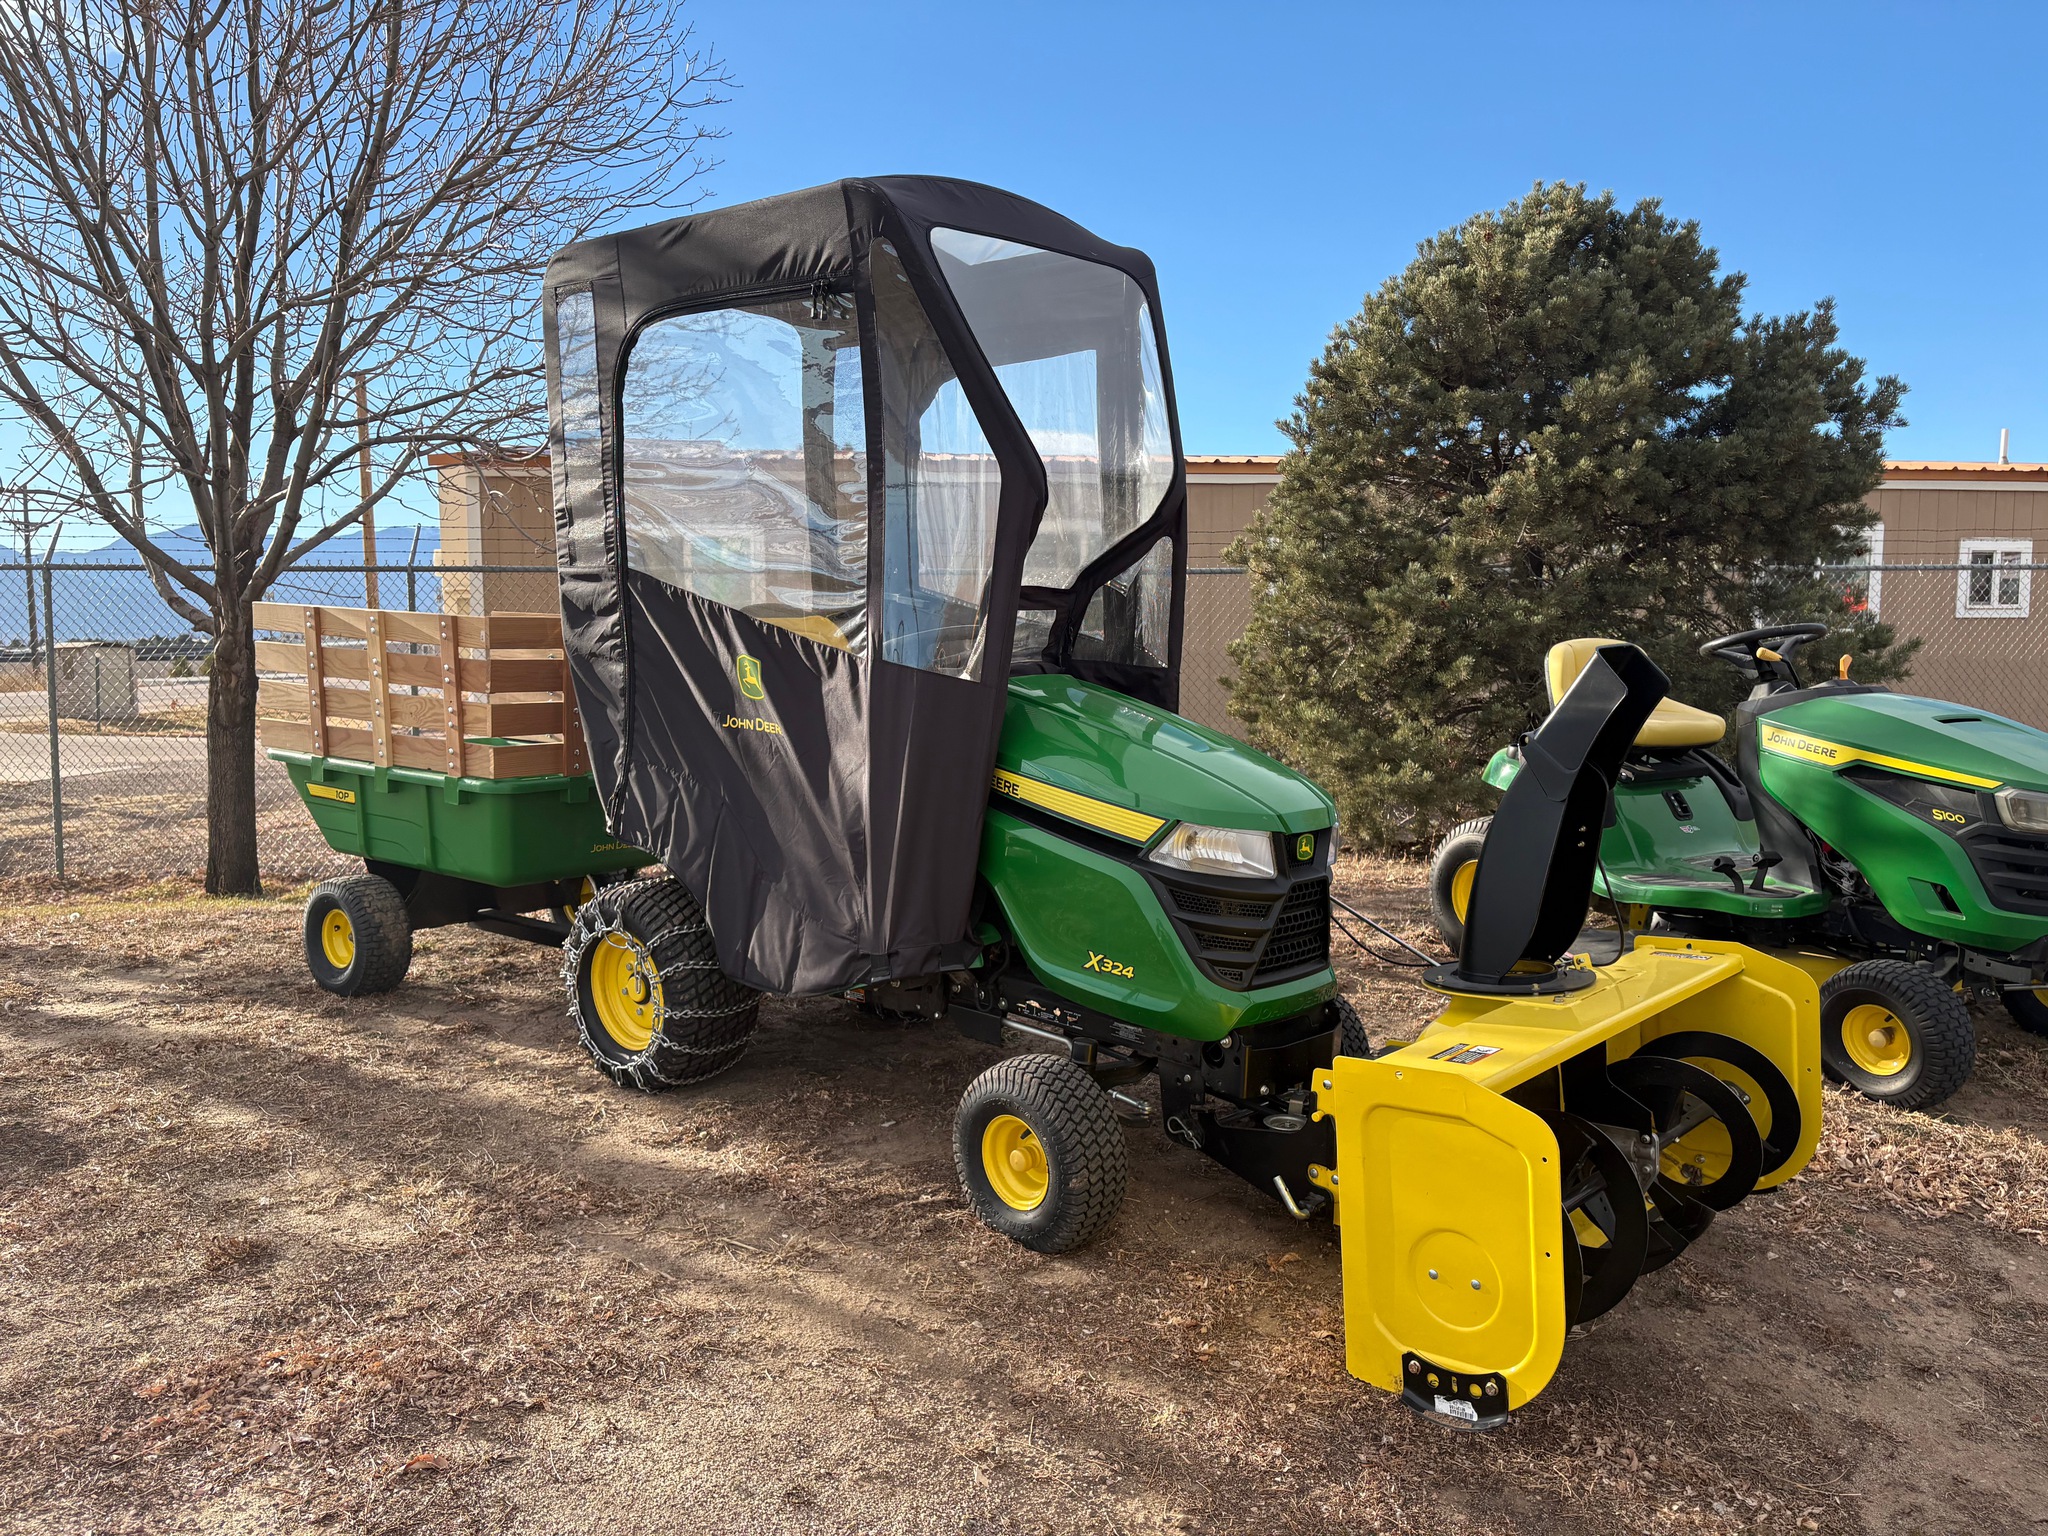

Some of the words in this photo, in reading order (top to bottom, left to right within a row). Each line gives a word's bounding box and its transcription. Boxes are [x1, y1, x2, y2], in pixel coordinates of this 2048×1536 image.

[722, 714, 754, 731] JOHN
[1767, 731, 1796, 748] JOHN
[1797, 739, 1838, 759] DEERE
[1932, 808, 1967, 825] S100
[590, 842, 615, 853] JOHN
[1082, 949, 1135, 980] X324
